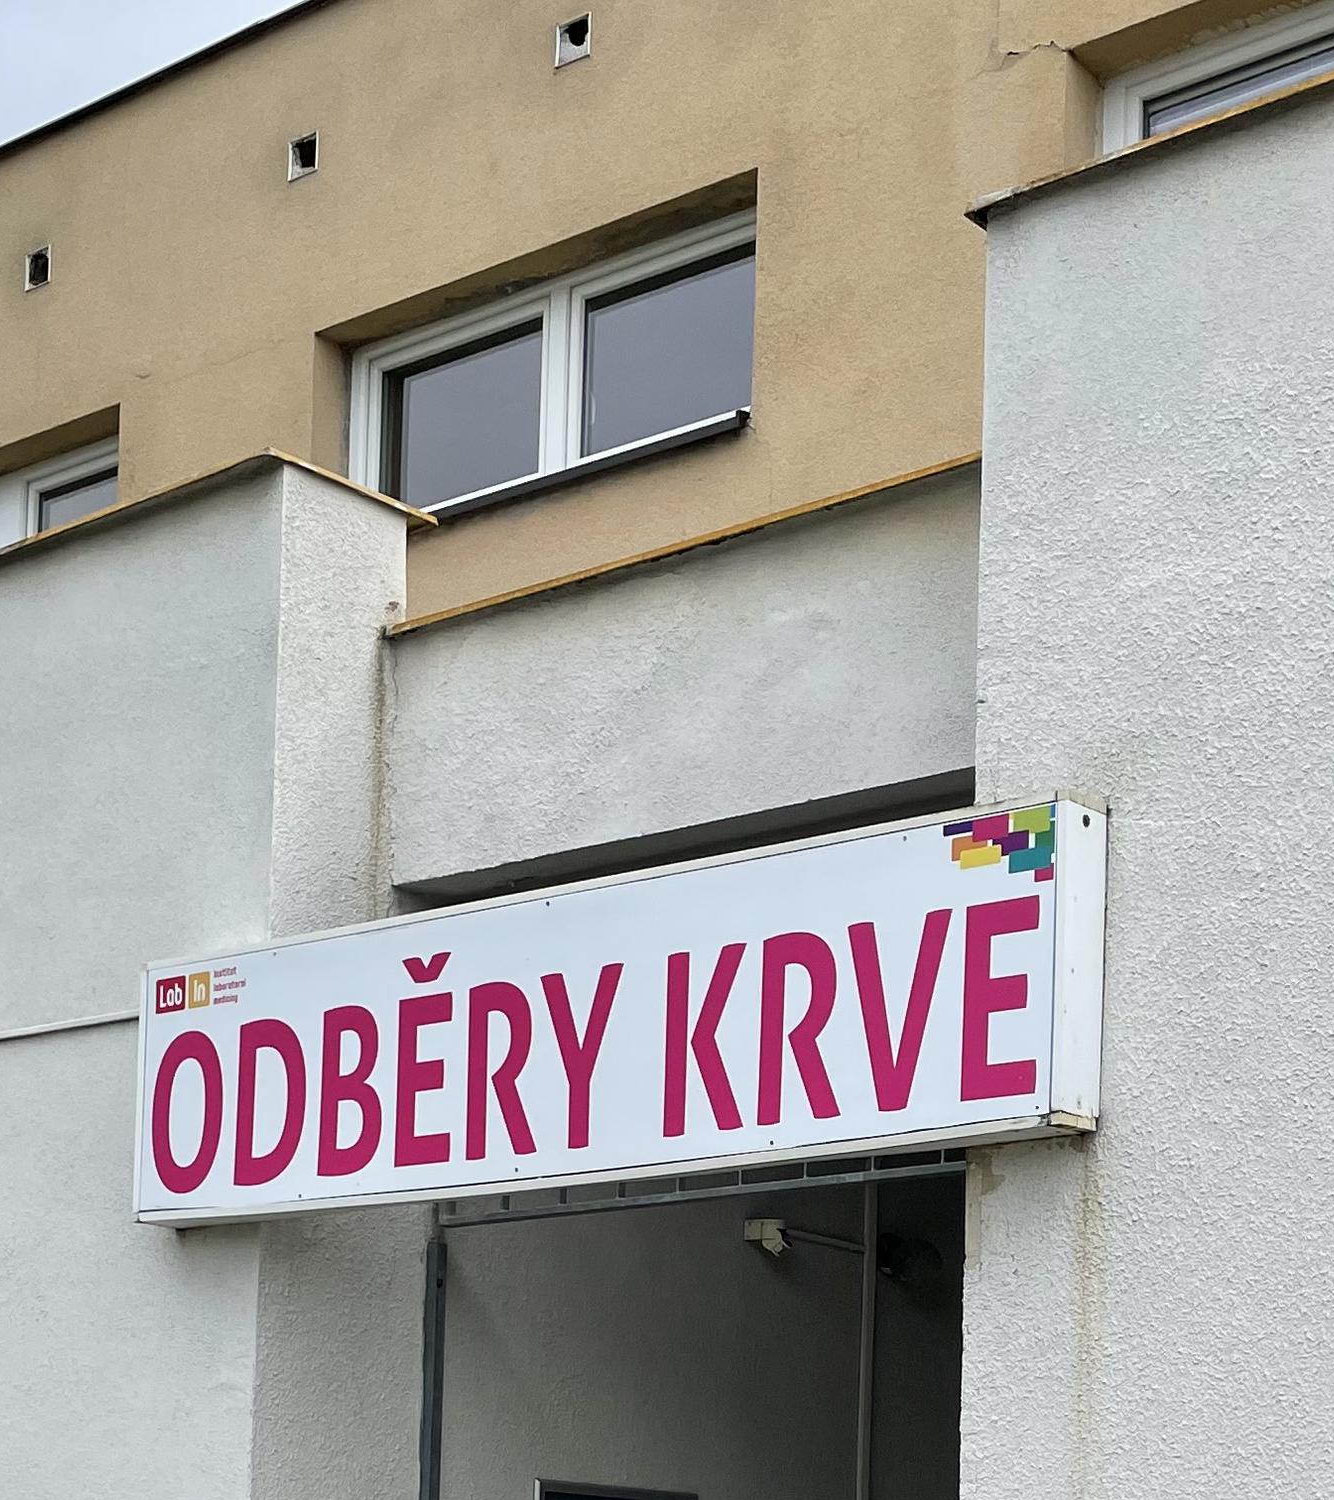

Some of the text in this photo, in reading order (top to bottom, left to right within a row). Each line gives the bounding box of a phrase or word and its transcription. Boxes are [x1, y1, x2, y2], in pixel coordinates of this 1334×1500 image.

[151, 895, 1041, 1194] ODBĚRY KRVE
[159, 978, 206, 1008] Lab In
